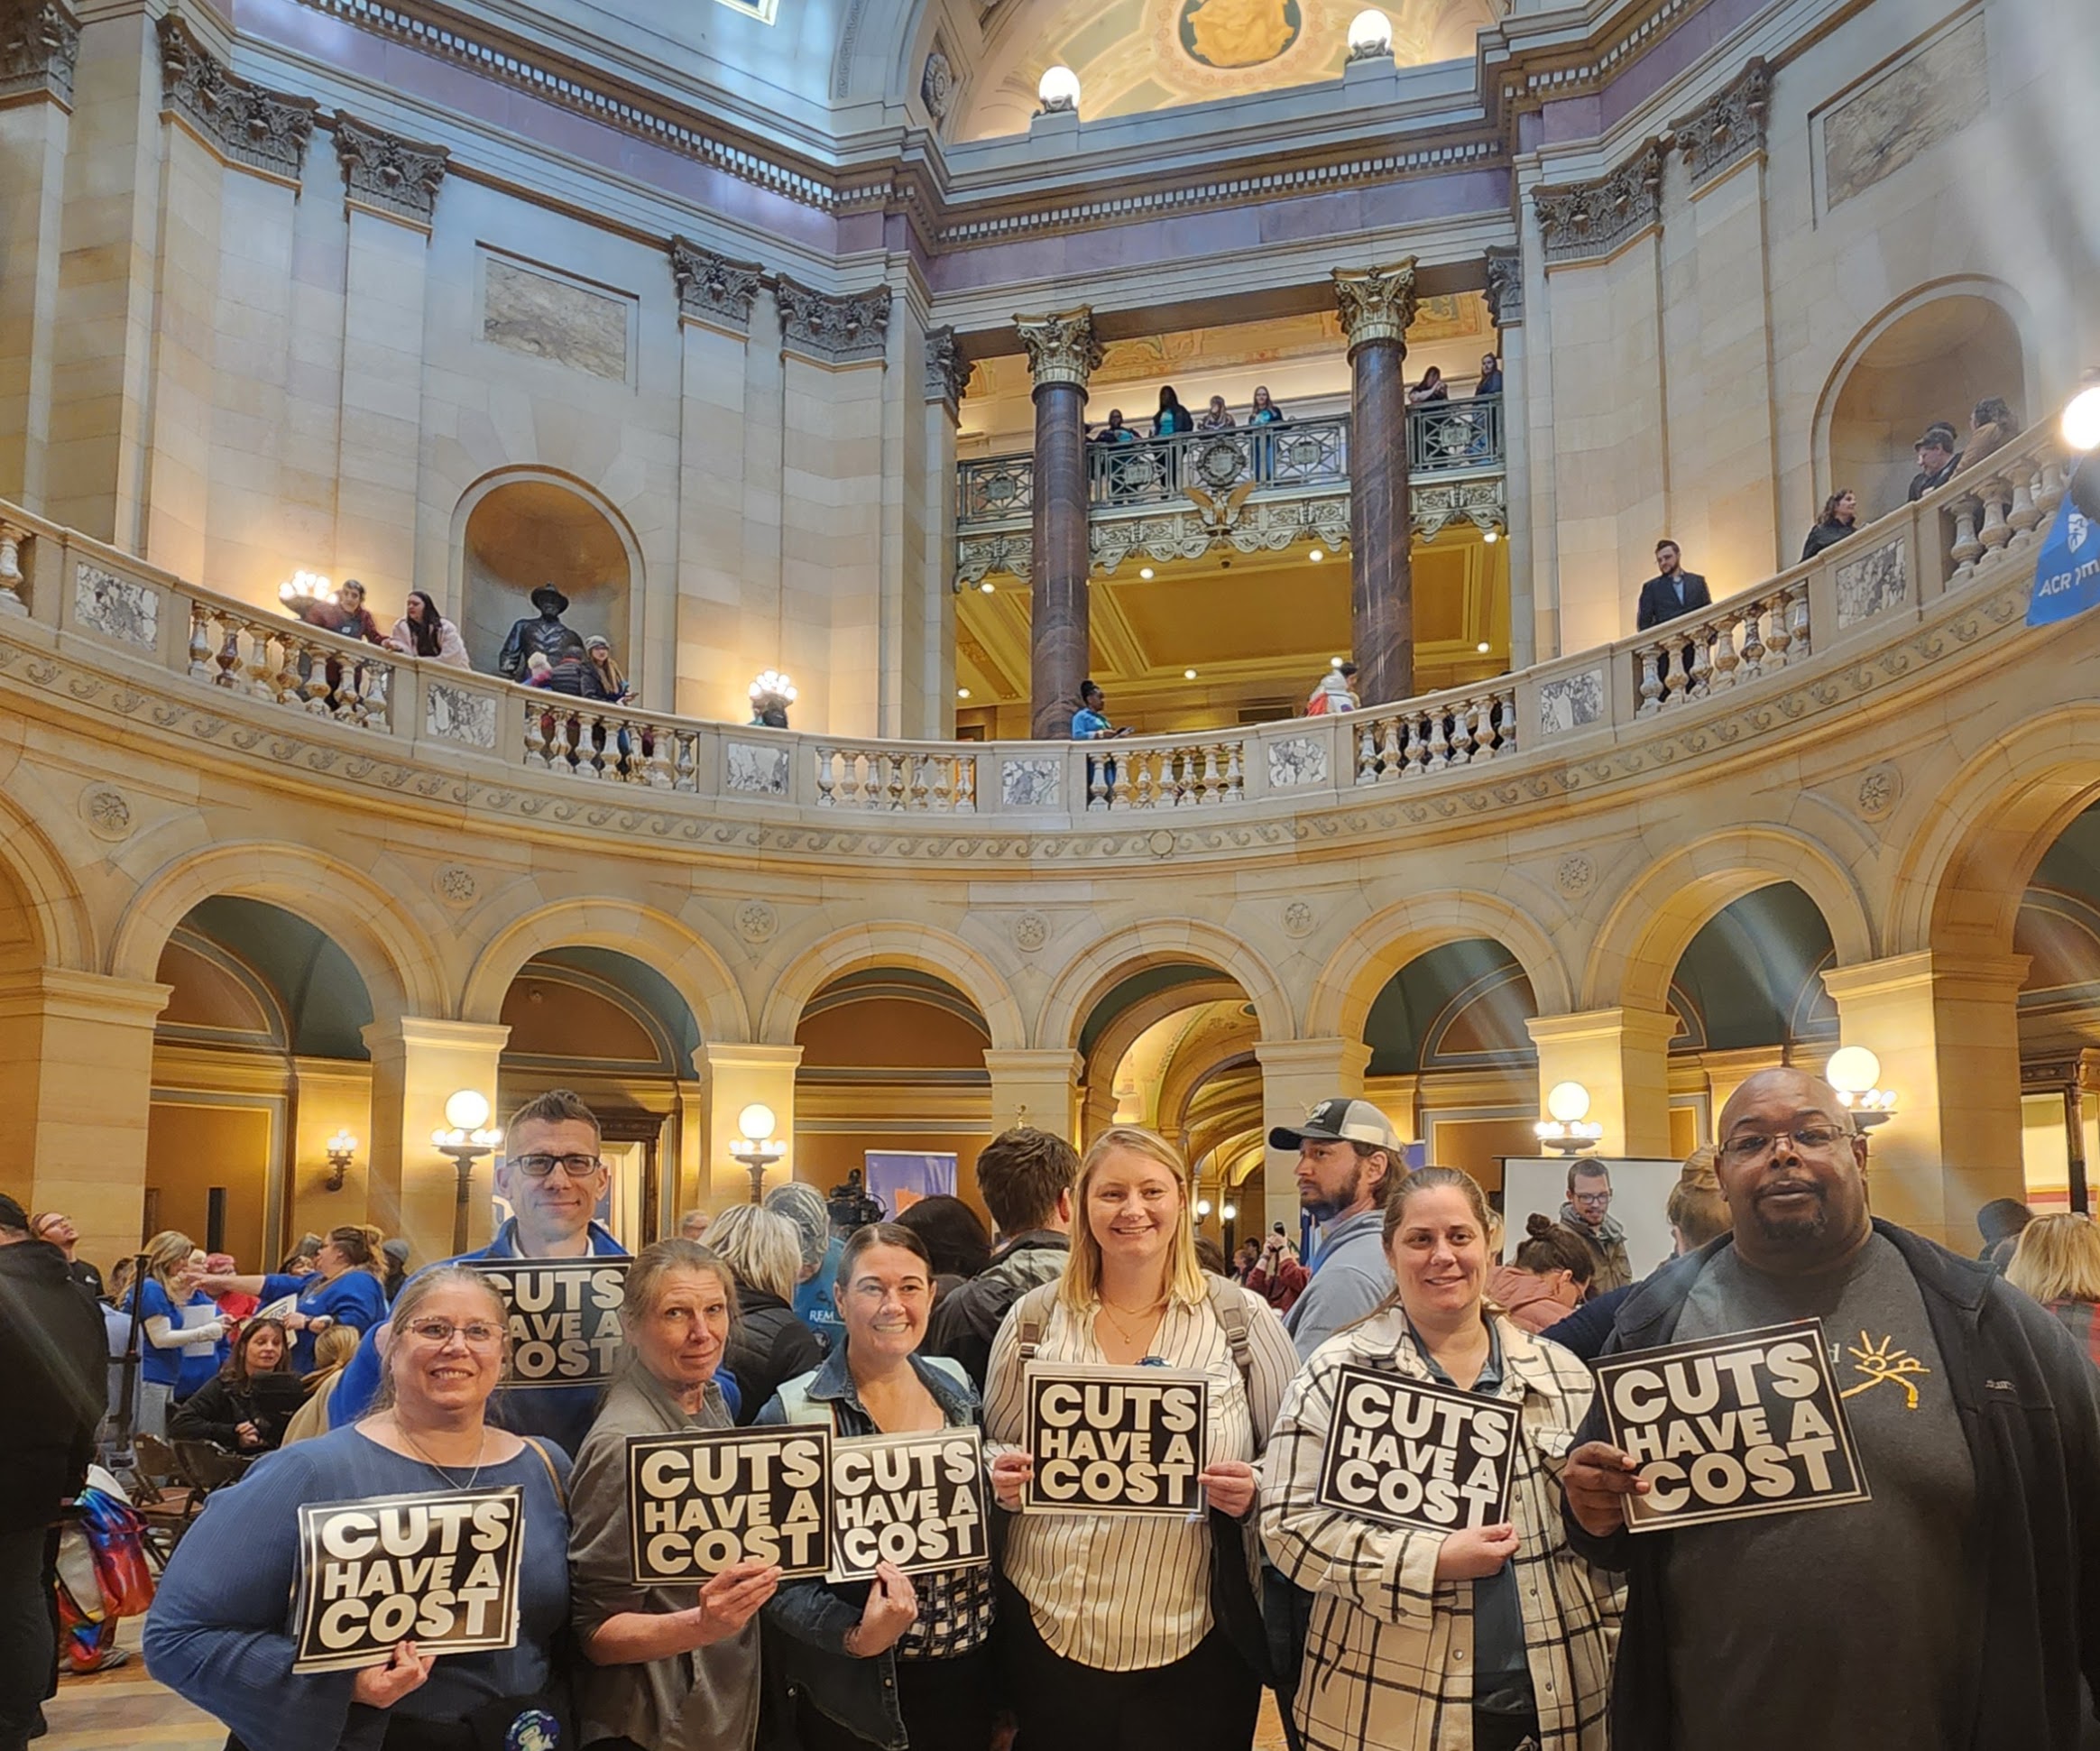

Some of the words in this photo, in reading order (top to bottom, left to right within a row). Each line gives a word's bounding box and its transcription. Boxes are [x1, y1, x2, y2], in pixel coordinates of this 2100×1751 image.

[2038, 572, 2072, 596] ACR
[509, 1312, 583, 1341] AVE
[594, 1310, 623, 1337] A
[514, 1337, 623, 1378] OST
[1613, 1342, 1820, 1424] CUTS
[1039, 1383, 1197, 1433] CUTS
[1346, 1382, 1509, 1458] CUTS
[1623, 1406, 1773, 1464] HAVE
[1790, 1399, 1834, 1442] A
[640, 1440, 822, 1499] CUTS
[833, 1441, 976, 1497] CUTS
[1040, 1428, 1152, 1462] HAVE
[1163, 1433, 1195, 1464] A
[1340, 1424, 1458, 1481] HAVE
[1466, 1457, 1500, 1493] A
[1637, 1435, 1838, 1512] COST
[835, 1488, 940, 1530] HAVE
[950, 1485, 979, 1516] A
[1040, 1459, 1194, 1505] COST
[1336, 1458, 1498, 1530] COST
[321, 1502, 511, 1560] CUTS
[643, 1493, 771, 1533] HAVE
[785, 1489, 821, 1523] A
[647, 1520, 820, 1575] COST
[843, 1513, 979, 1568] COST
[323, 1555, 457, 1600] HAVE
[464, 1553, 502, 1588] A
[318, 1587, 499, 1649] COST
